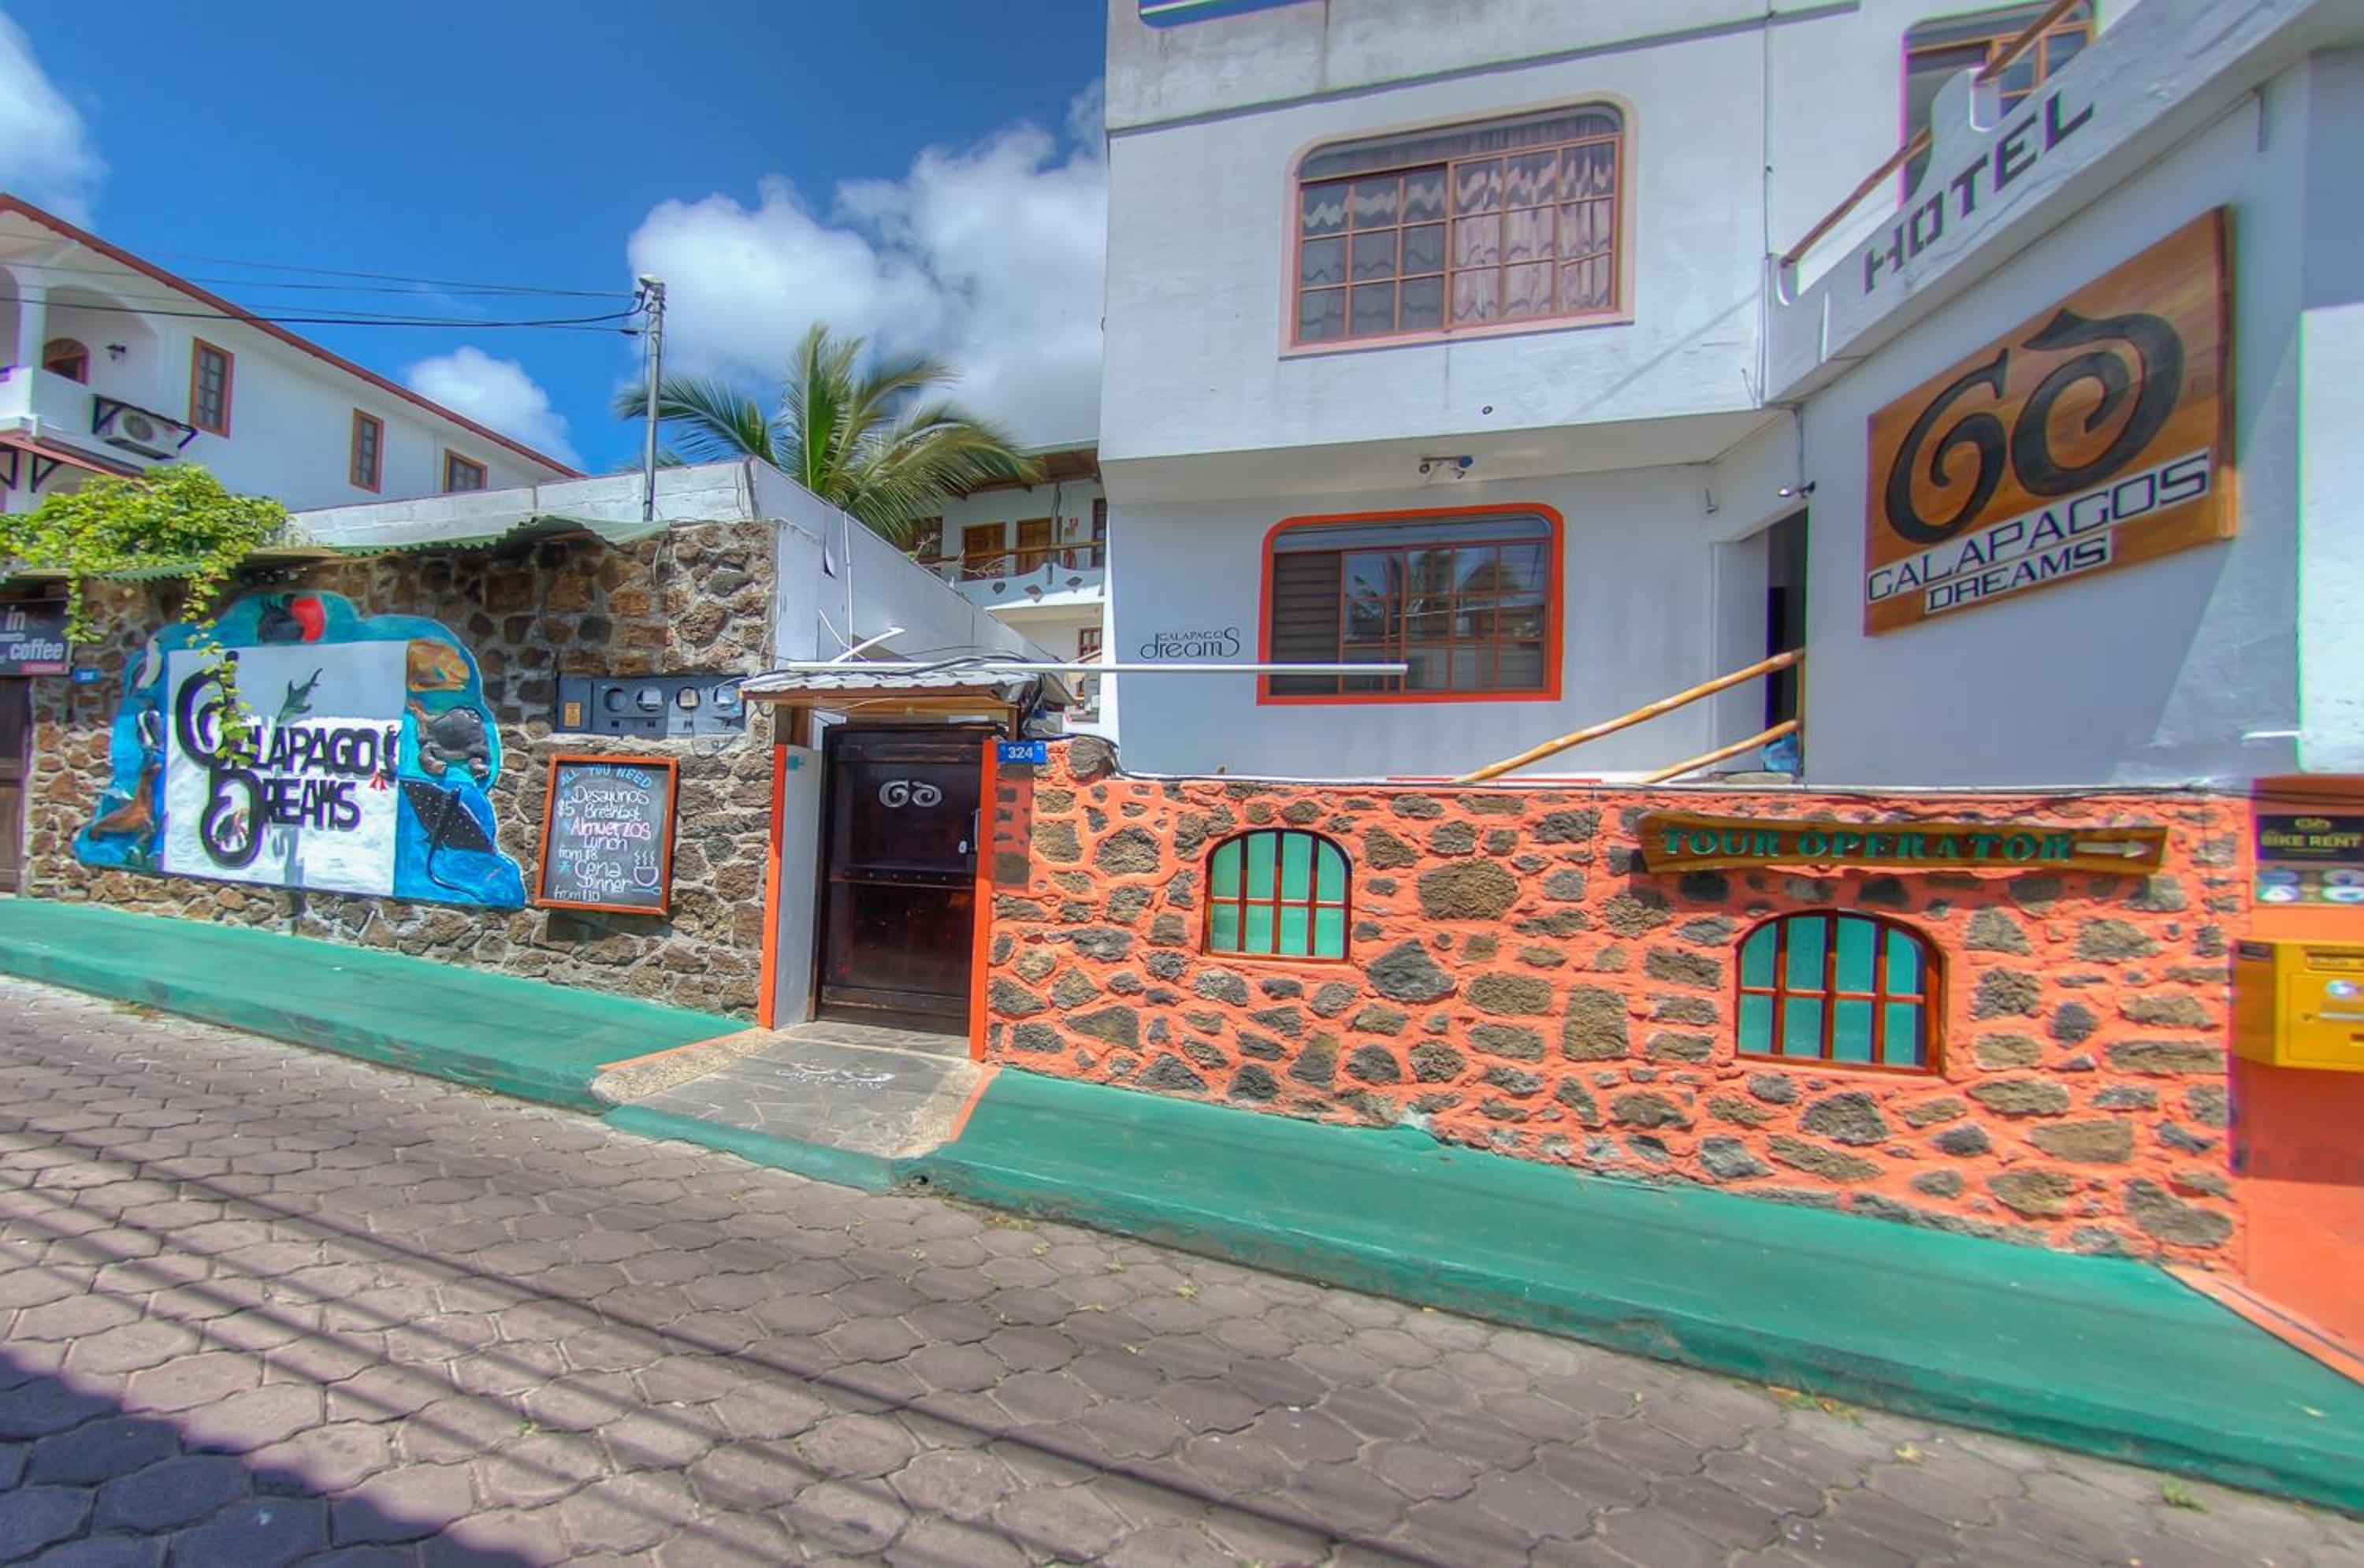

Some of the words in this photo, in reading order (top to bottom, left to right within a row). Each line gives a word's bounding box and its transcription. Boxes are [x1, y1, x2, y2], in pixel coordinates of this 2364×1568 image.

[1864, 88, 2095, 296] HOTEL
[1868, 453, 2208, 602] GALAPAGOS
[1928, 537, 2107, 612] DREAMS
[1008, 745, 1033, 759] 324
[616, 767, 652, 788] NEED
[1663, 828, 1780, 858] TOUR
[1797, 830, 2073, 863] OPERATOR
[575, 860, 622, 879] Cena
[576, 876, 634, 894] Dinner
